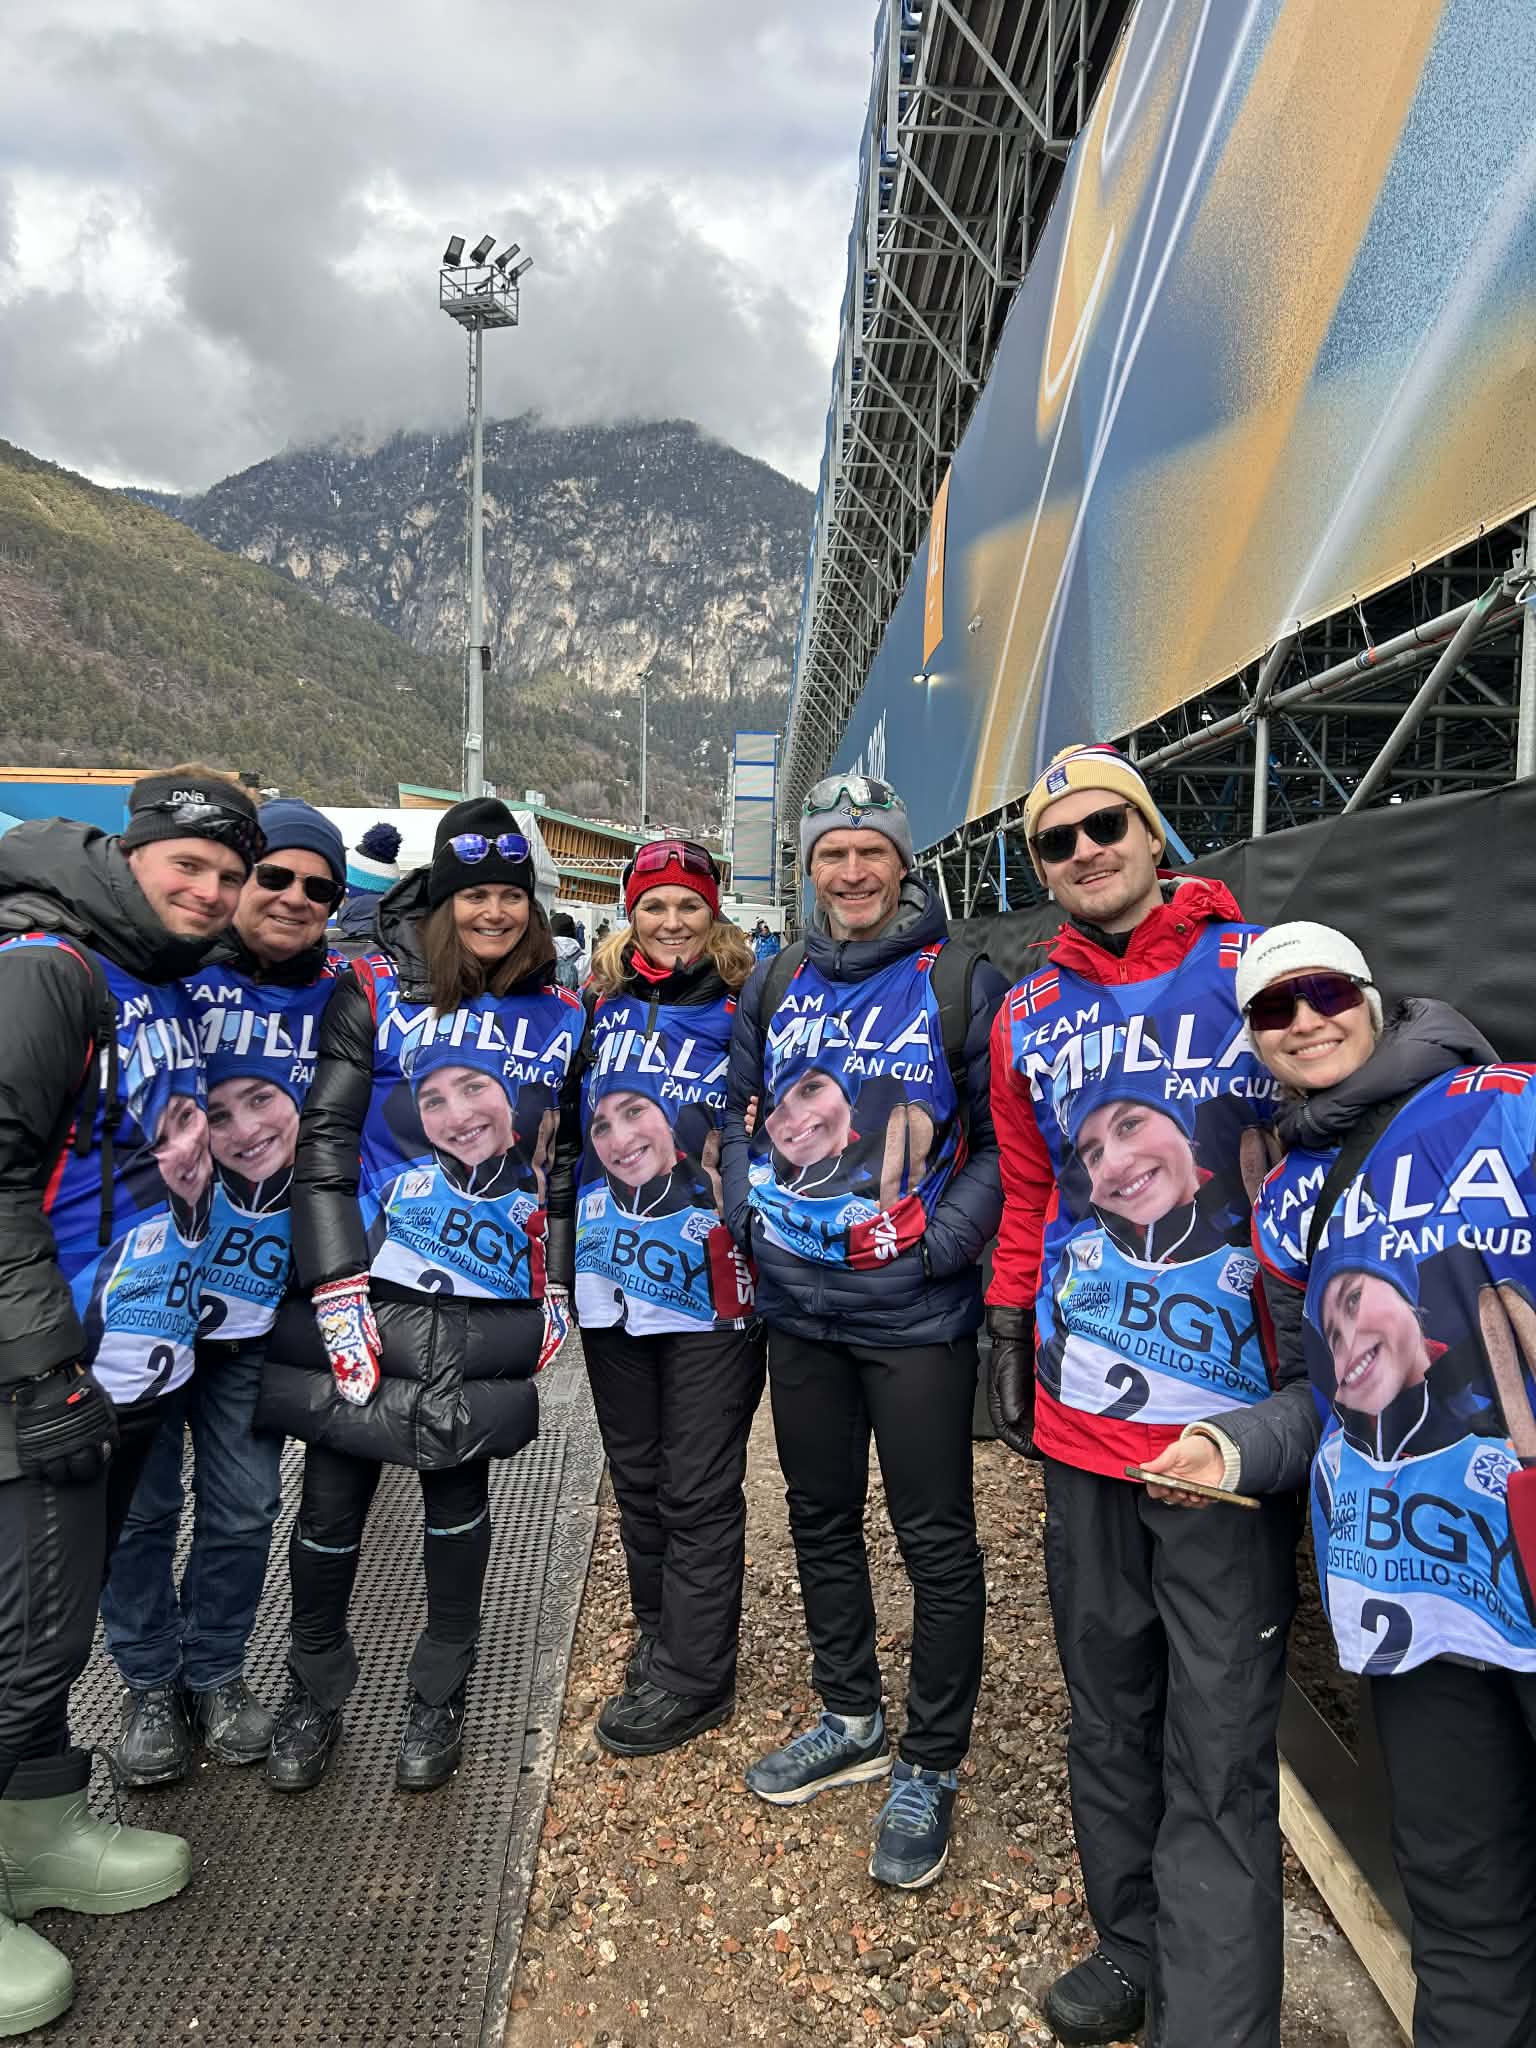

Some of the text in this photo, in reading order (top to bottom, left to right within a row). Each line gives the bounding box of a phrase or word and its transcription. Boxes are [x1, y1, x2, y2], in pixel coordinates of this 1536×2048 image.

[172, 790, 206, 803] DNB
[116, 994, 152, 1029] AM
[777, 993, 825, 1012] AM
[378, 1007, 572, 1077] MILLA
[1023, 1001, 1101, 1051] TEAM
[503, 1060, 540, 1083] FAN
[842, 1056, 885, 1077] FAN
[1164, 1077, 1219, 1100] FAN
[660, 1081, 702, 1102] FAN
[1263, 1164, 1325, 1240] TAM
[212, 1226, 287, 1280] BG
[439, 1207, 528, 1278] BGY
[611, 1228, 707, 1292] BGY
[1380, 1223, 1532, 1260] FAN CLUB
[1081, 1281, 1112, 1292] MILAN
[1118, 1281, 1258, 1369] BGY
[135, 1345, 175, 1401] 2
[1135, 1339, 1193, 1372] DELLO
[1104, 1363, 1151, 1420] 2
[1364, 1487, 1514, 1584] BGY
[1328, 1546, 1378, 1579] OSTEGNO
[1385, 1557, 1450, 1586] DELLO
[1360, 1598, 1413, 1675] 2
